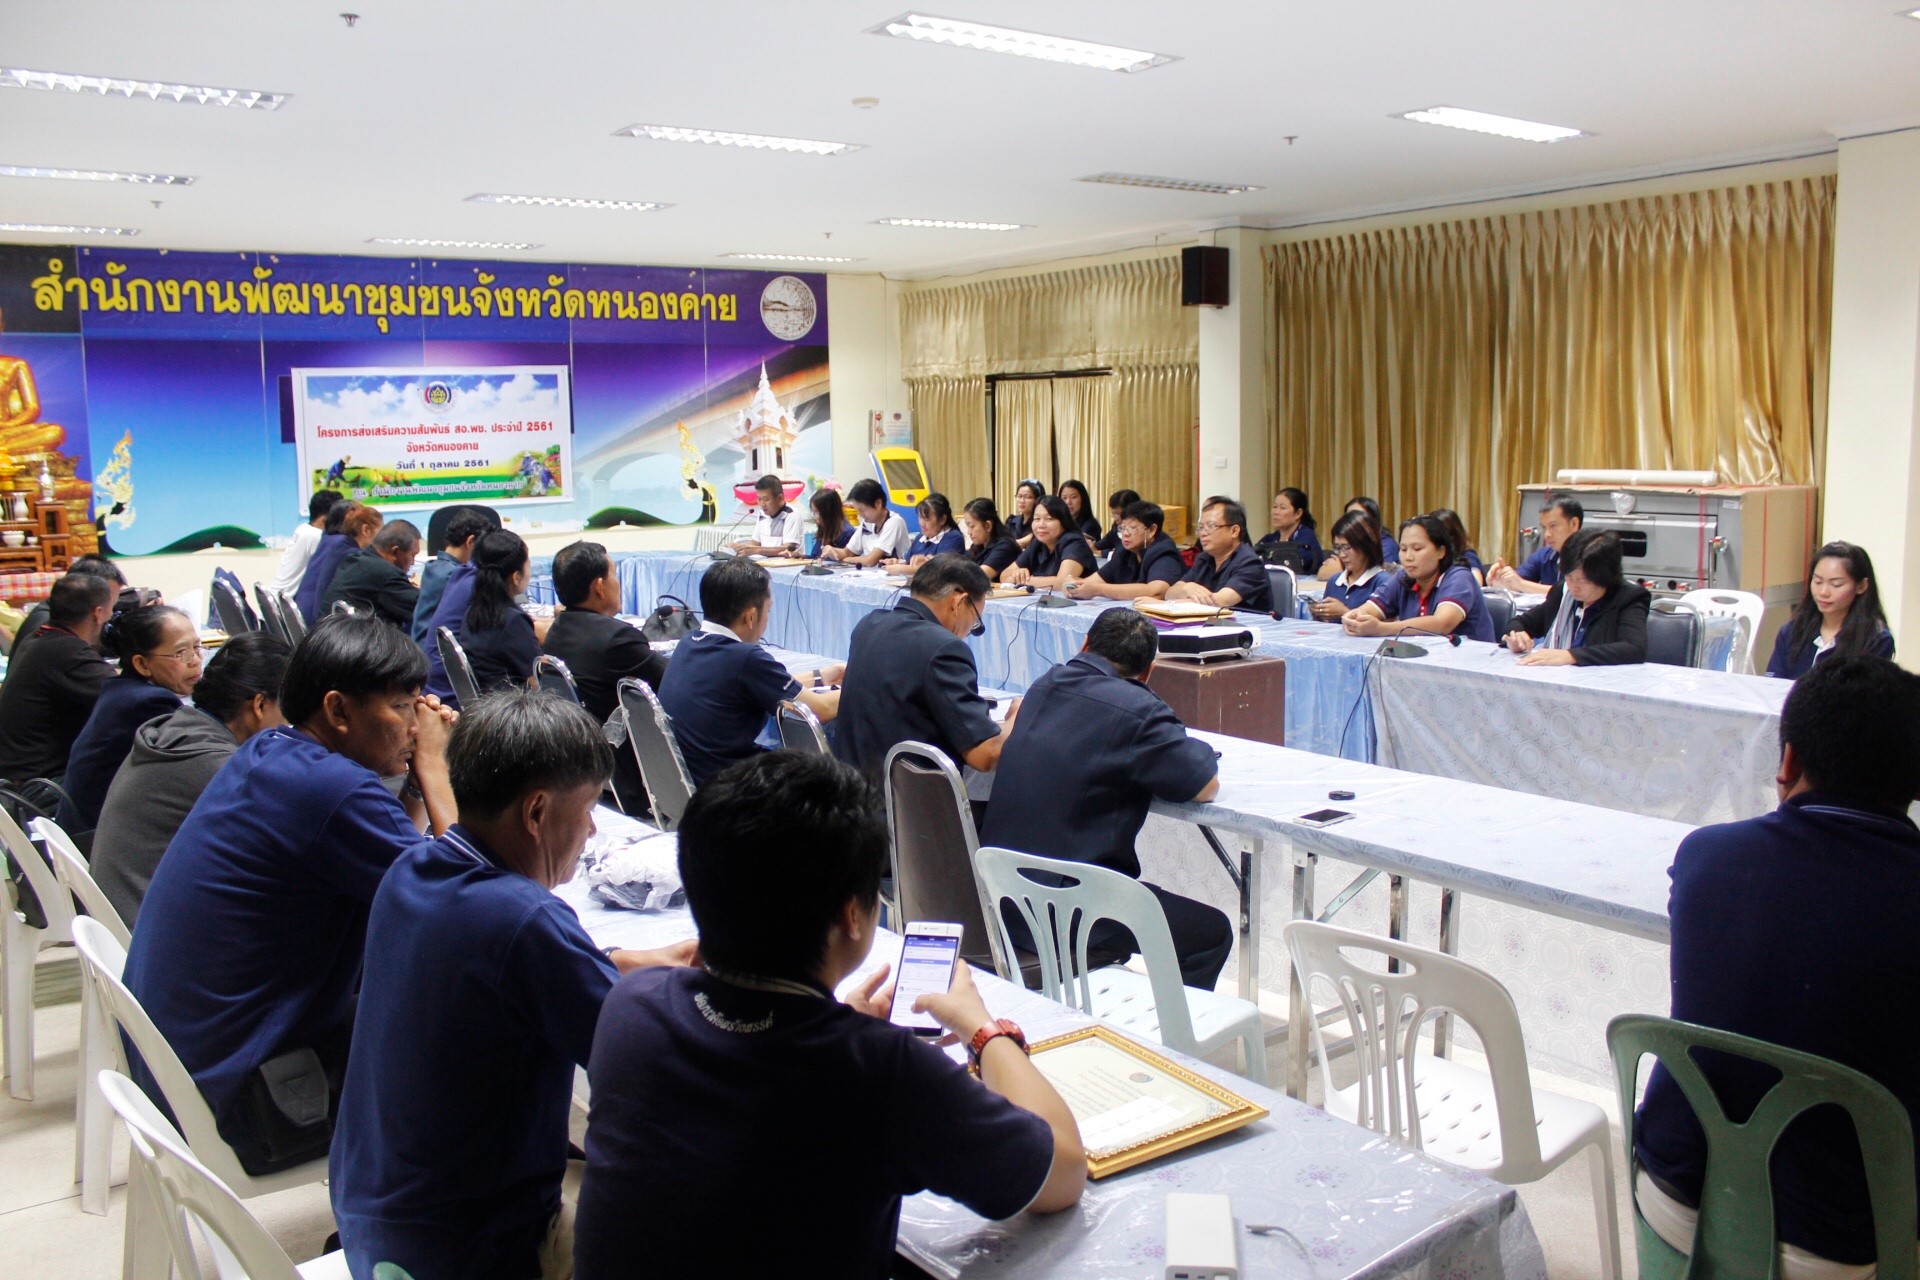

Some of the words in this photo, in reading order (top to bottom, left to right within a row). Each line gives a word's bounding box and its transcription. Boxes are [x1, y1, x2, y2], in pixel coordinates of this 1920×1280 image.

[31, 258, 737, 331] สำนักงานพัฒนาชุมชนจังหวัดหนองคาย
[317, 422, 450, 438] โครงการส่งเสริมความสัมพันธ์
[455, 423, 487, 434] สอ.พช.
[491, 420, 522, 433] ประจำปี
[527, 421, 553, 431] 2561
[406, 441, 479, 452] จังหวัดหนองคาย
[396, 458, 416, 469] วันที่
[429, 461, 459, 470] ตุลาคม
